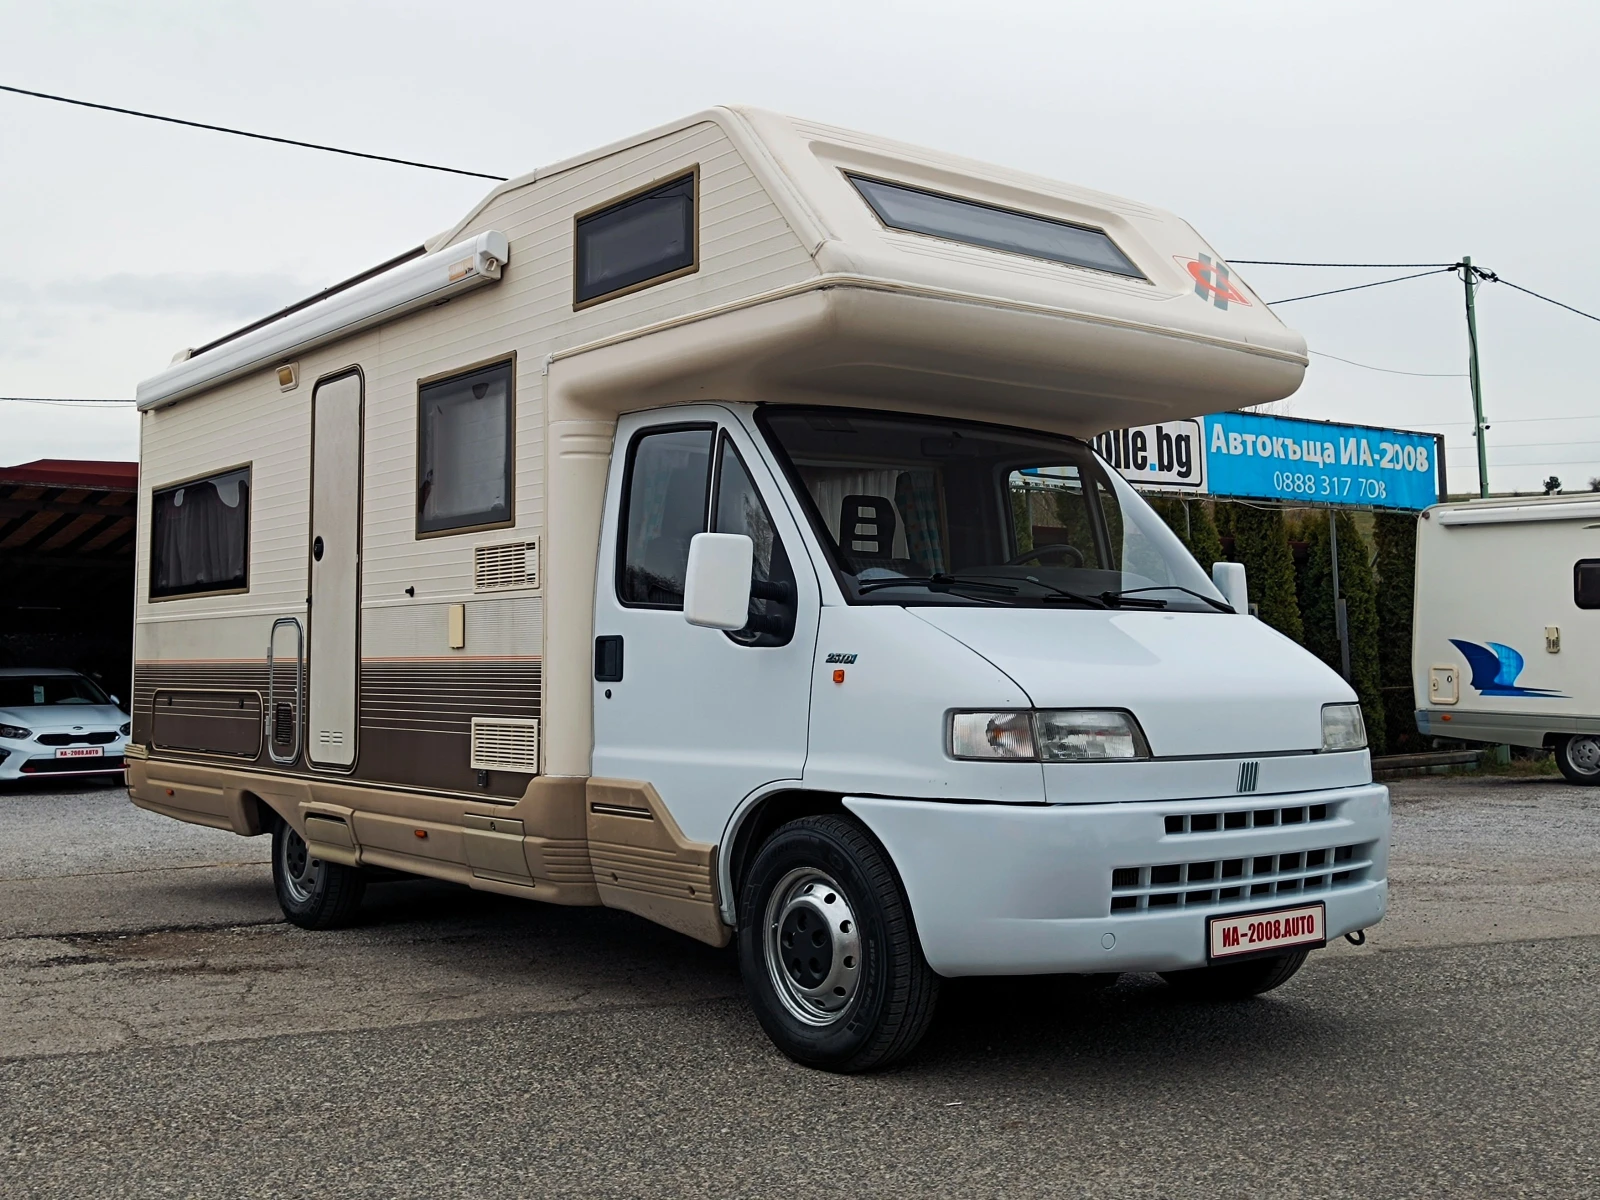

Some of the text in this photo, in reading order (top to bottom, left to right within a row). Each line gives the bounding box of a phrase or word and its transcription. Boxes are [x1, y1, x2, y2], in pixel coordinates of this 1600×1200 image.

[1210, 423, 1429, 472] Автокъща ИА-2008
[1273, 470, 1387, 499] 0888 317 708
[1222, 914, 1314, 947] ИА-2008.AUTO
